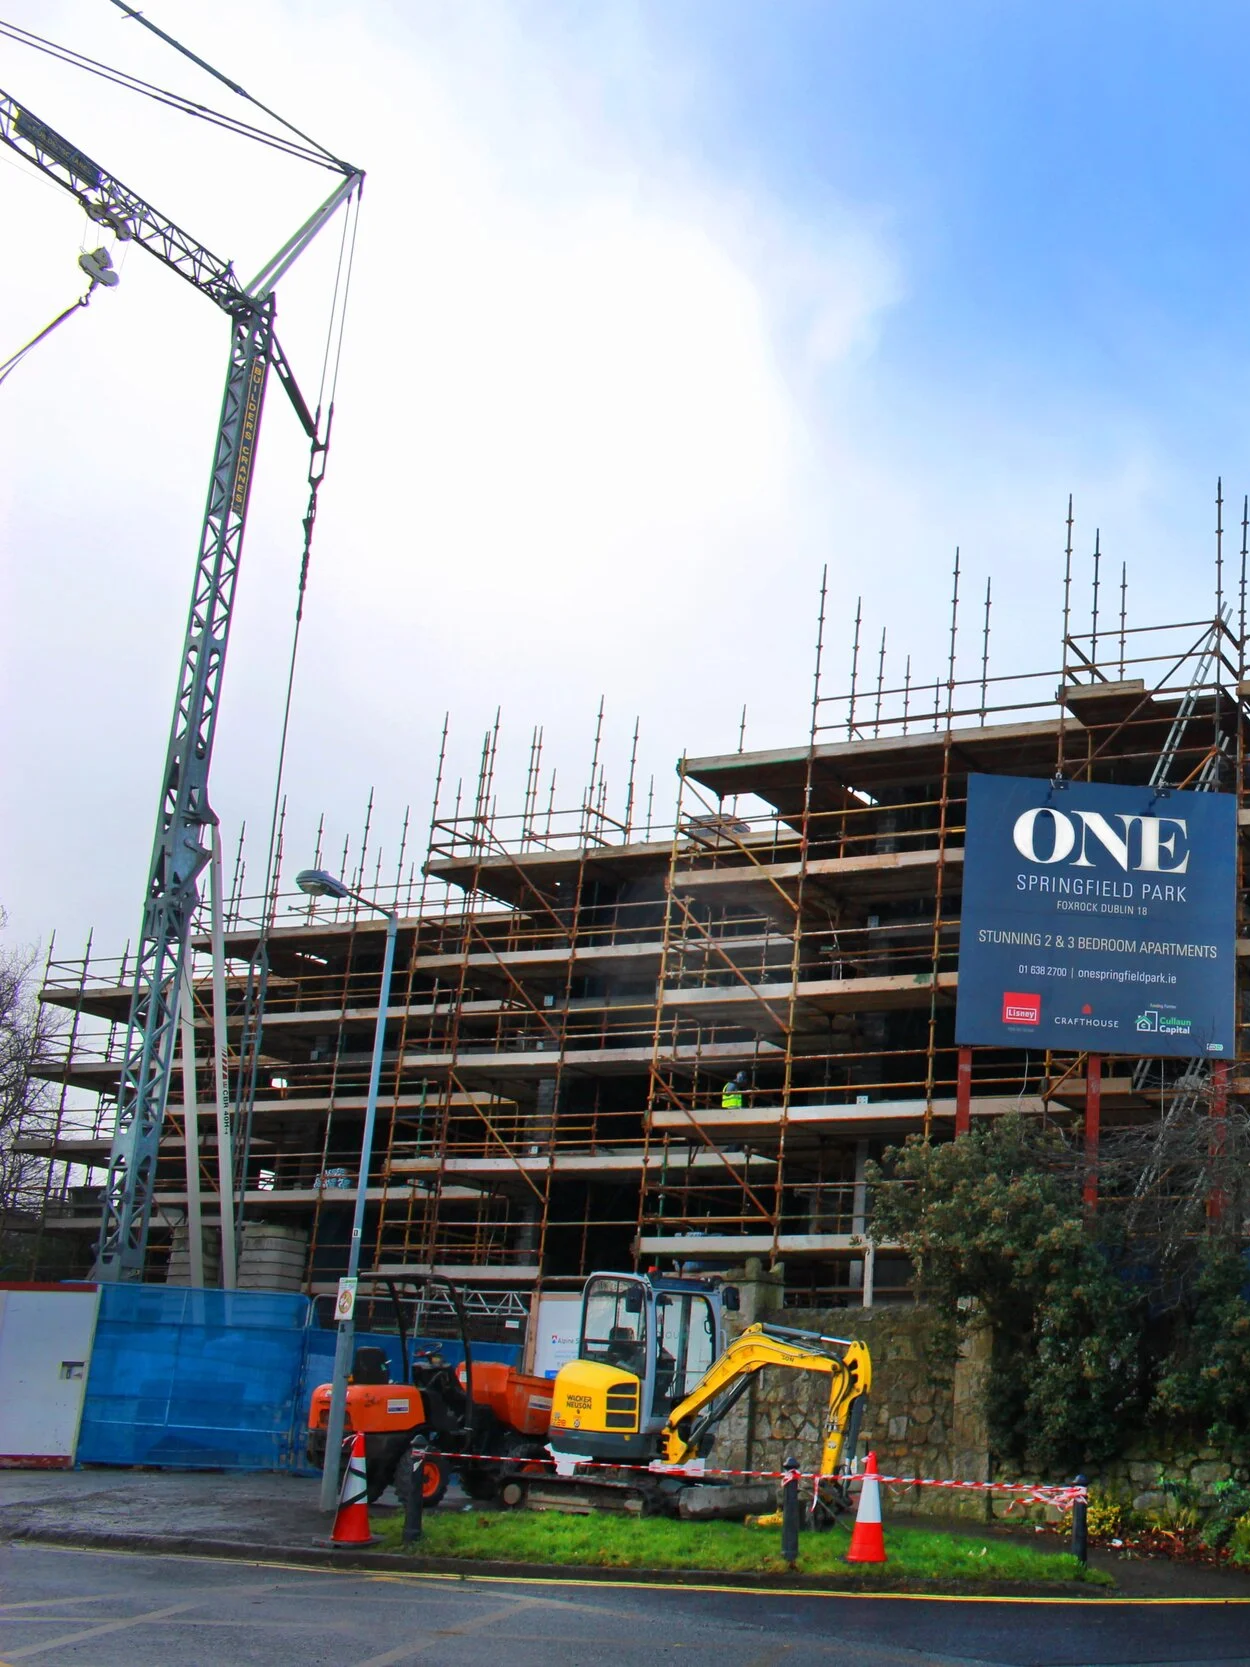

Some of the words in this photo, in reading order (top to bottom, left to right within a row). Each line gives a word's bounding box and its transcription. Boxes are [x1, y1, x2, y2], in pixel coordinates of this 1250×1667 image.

[244, 367, 262, 440] BUILDERS
[234, 446, 250, 503] CRANES
[1013, 807, 1190, 874] ONE
[1016, 874, 1134, 899] SPRINGFIELD
[1142, 883, 1188, 903] PARK
[1057, 900, 1098, 913] FOXROCK
[1101, 903, 1134, 915] DUBLIN
[1137, 905, 1148, 916] 18
[978, 929, 1042, 947] STUNNING
[1044, 935, 1052, 948] 2
[1055, 935, 1065, 949] &
[1067, 936, 1075, 949] 3
[1078, 936, 1137, 954] BEDROOM
[1139, 940, 1218, 959] APARTMENTS
[1018, 964, 1029, 976] 01
[1030, 965, 1046, 977] 638
[1047, 966, 1067, 977] 2700
[1078, 968, 1177, 984] onespringfieldpark.ie
[1008, 1009, 1035, 1019] Lisney
[1054, 1016, 1119, 1028] CRAFTHOUSE
[1159, 1017, 1192, 1026] Cullaun
[1159, 1025, 1190, 1035] Capital
[566, 1401, 592, 1410] NEUSON
